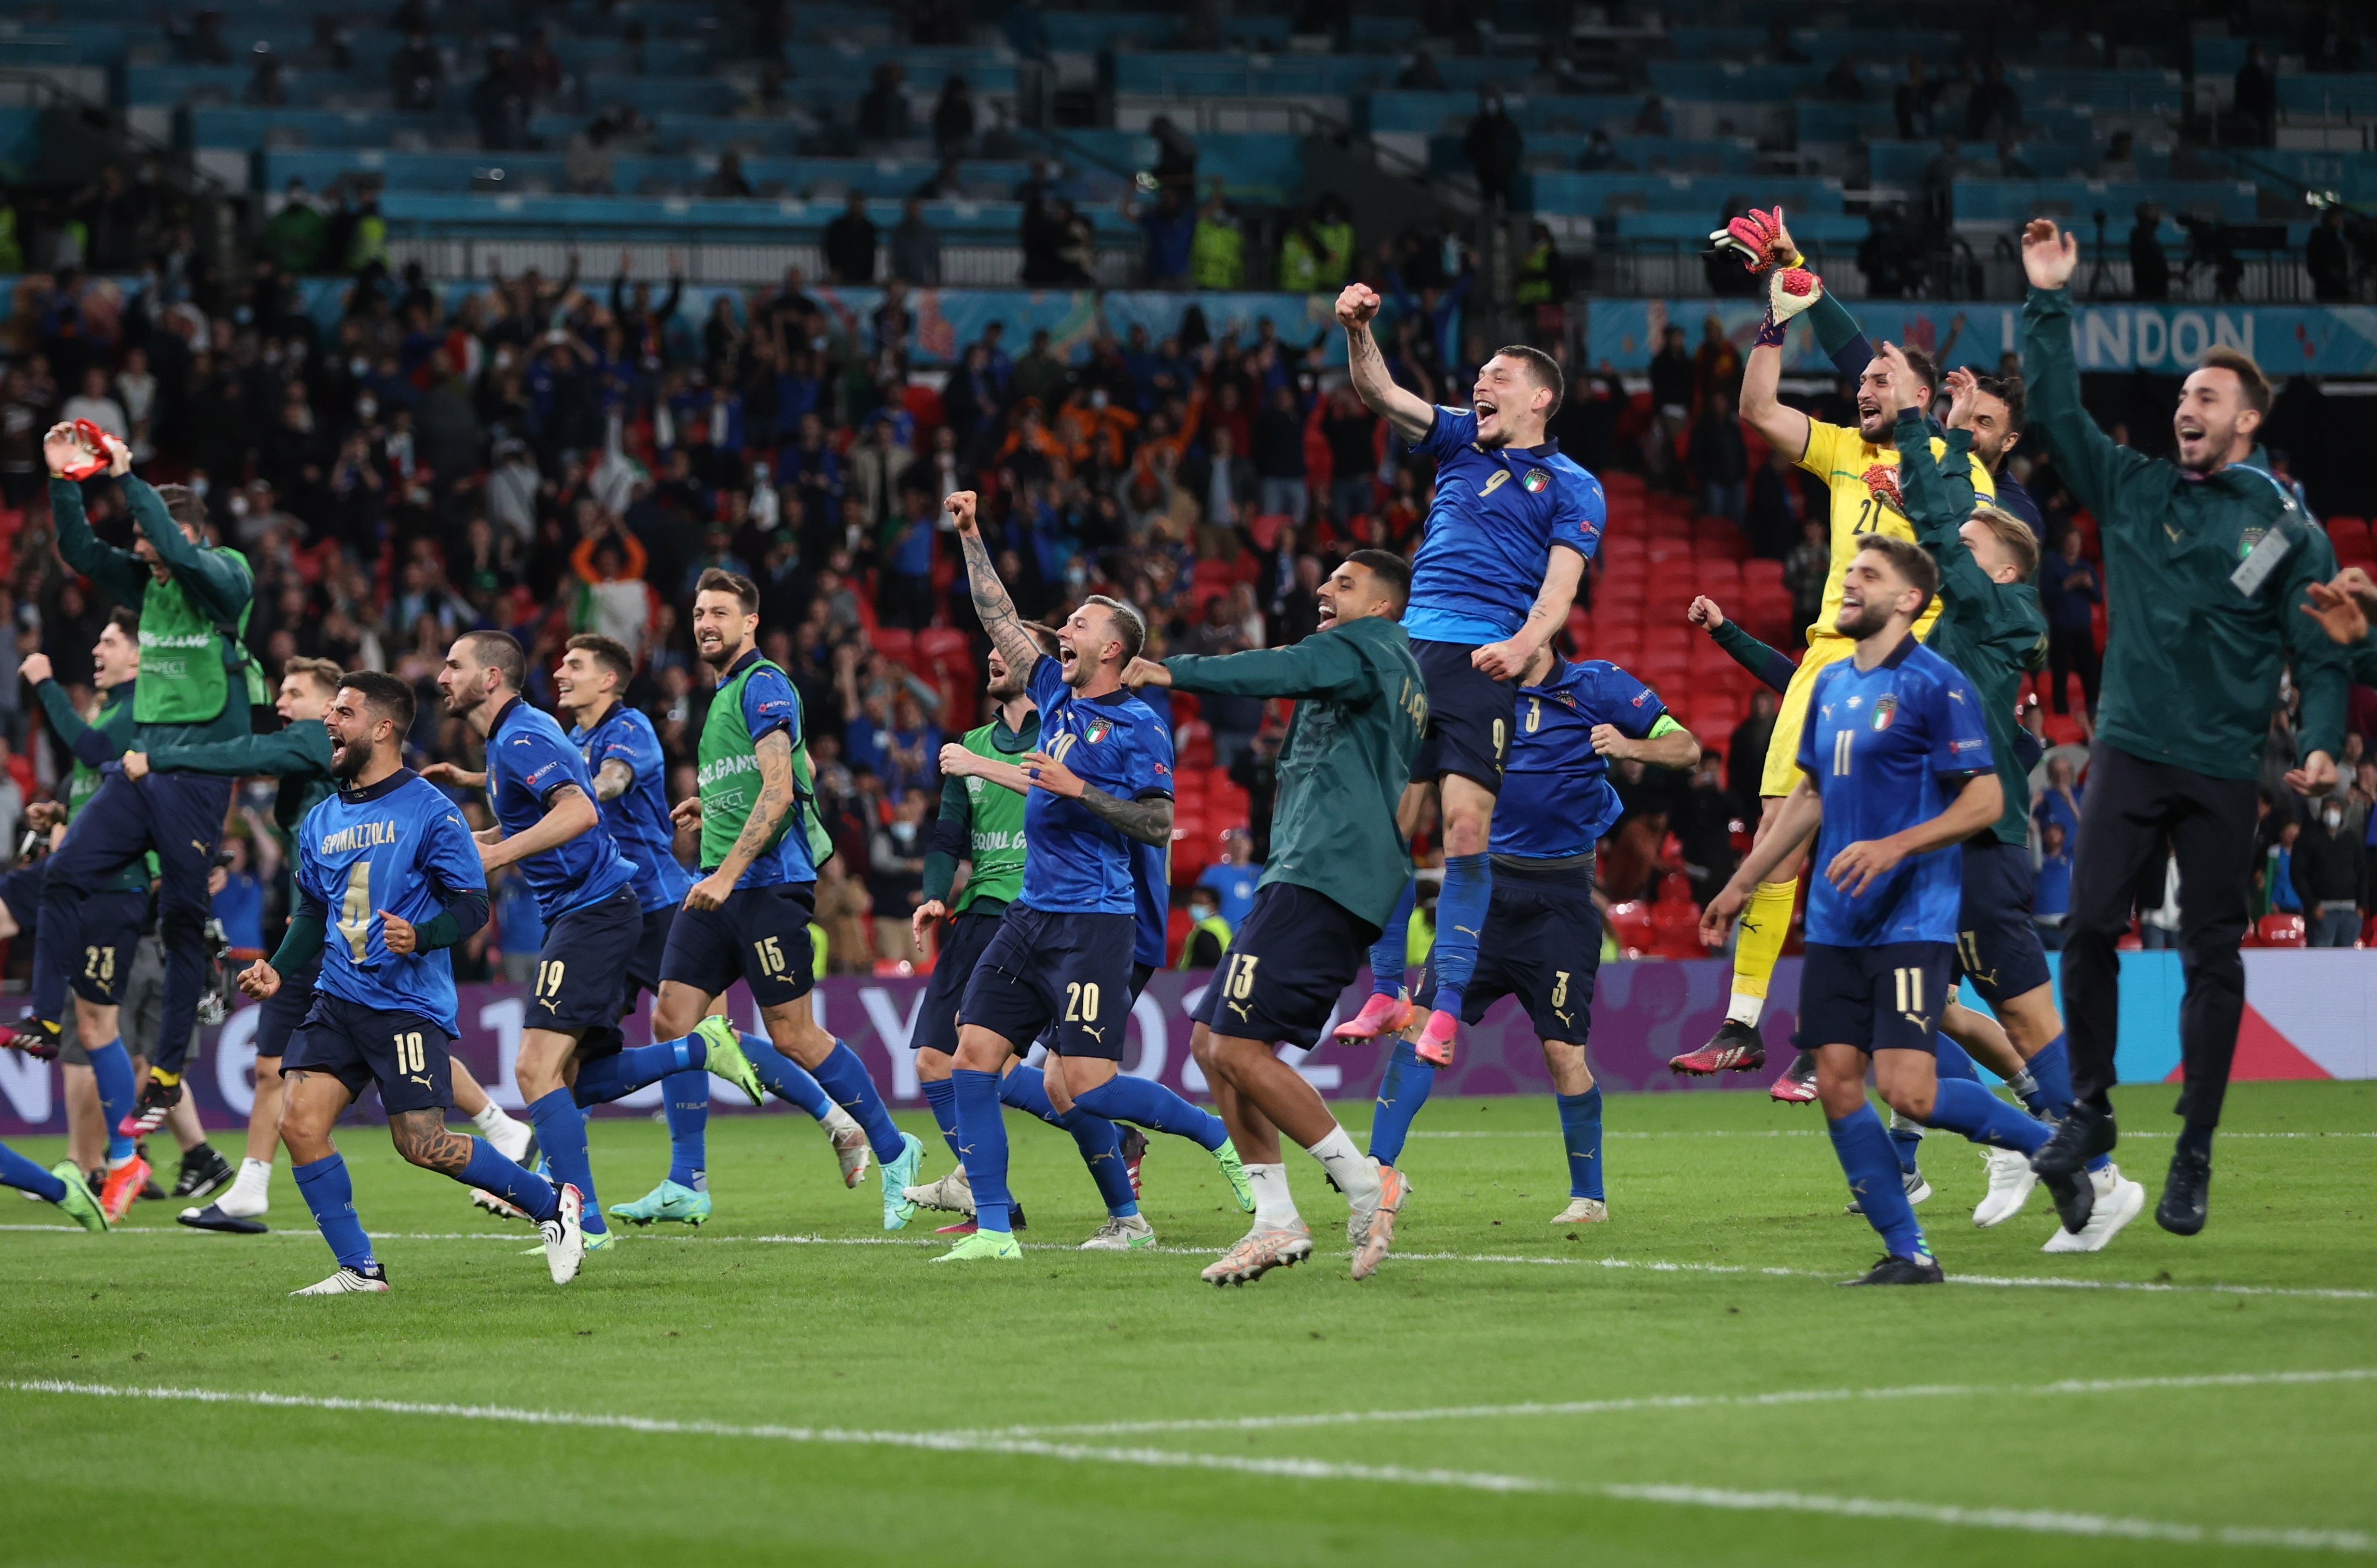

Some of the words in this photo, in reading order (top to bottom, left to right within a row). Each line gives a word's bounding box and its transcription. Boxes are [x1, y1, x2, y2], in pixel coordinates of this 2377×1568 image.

[2001, 309, 2254, 367] LNDON
[1478, 469, 1511, 497] 9
[1851, 498, 1882, 535] 21
[766, 700, 790, 709] RESPECT
[1526, 696, 1540, 733] 3
[1046, 727, 1077, 764] 20
[1492, 718, 1505, 760] 9
[1833, 729, 1854, 776] 11
[534, 761, 558, 778] RESPECT
[321, 820, 396, 855] SPINAZZOLA
[336, 861, 371, 964] 4
[84, 945, 116, 981] 23
[754, 935, 785, 976] 15
[1955, 931, 1982, 971] 17
[535, 960, 565, 997] 19
[1223, 953, 1260, 1000] 13
[1552, 970, 1570, 1008] 3
[1894, 968, 1923, 1012] 11
[1065, 982, 1099, 1022] 20
[393, 1031, 425, 1075] 10
